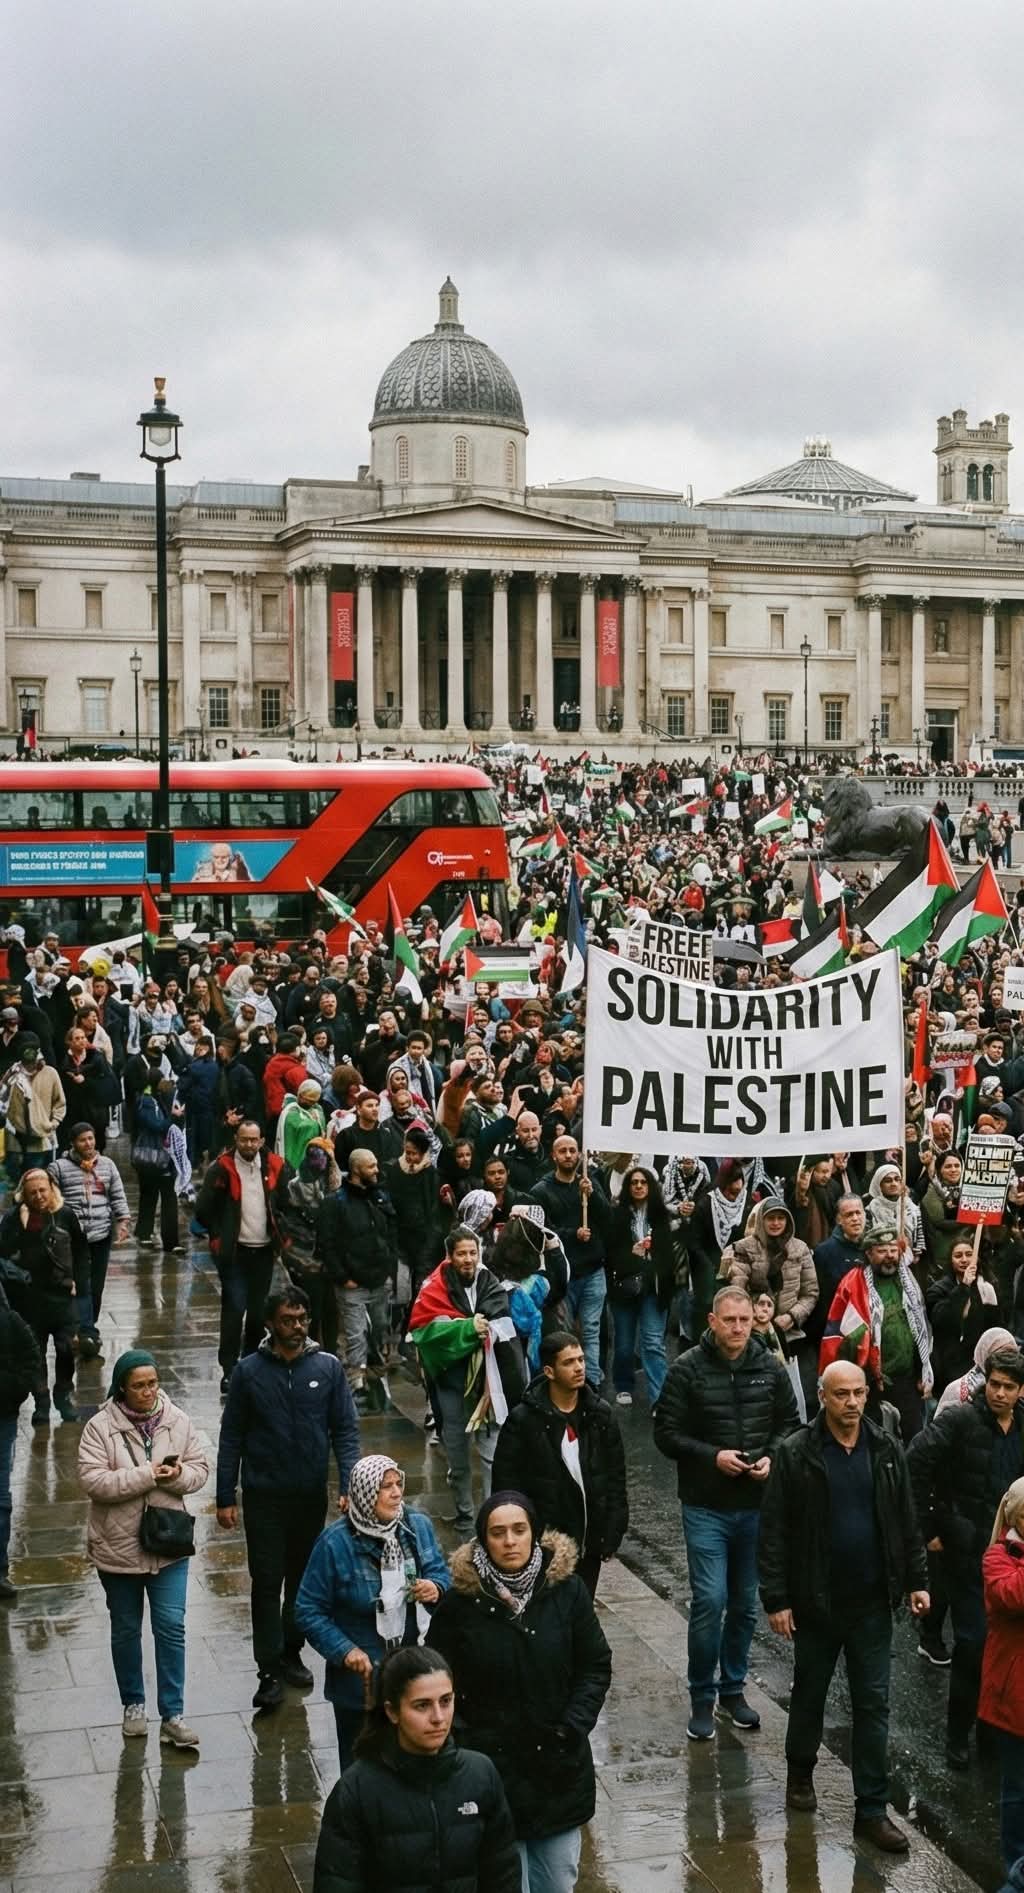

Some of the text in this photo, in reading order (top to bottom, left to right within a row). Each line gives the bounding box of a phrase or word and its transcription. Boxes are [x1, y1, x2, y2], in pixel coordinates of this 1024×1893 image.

[607, 966, 882, 1031] SOLIDARITY
[707, 1035, 783, 1070] WITH
[600, 1064, 888, 1136] PALESTINE
